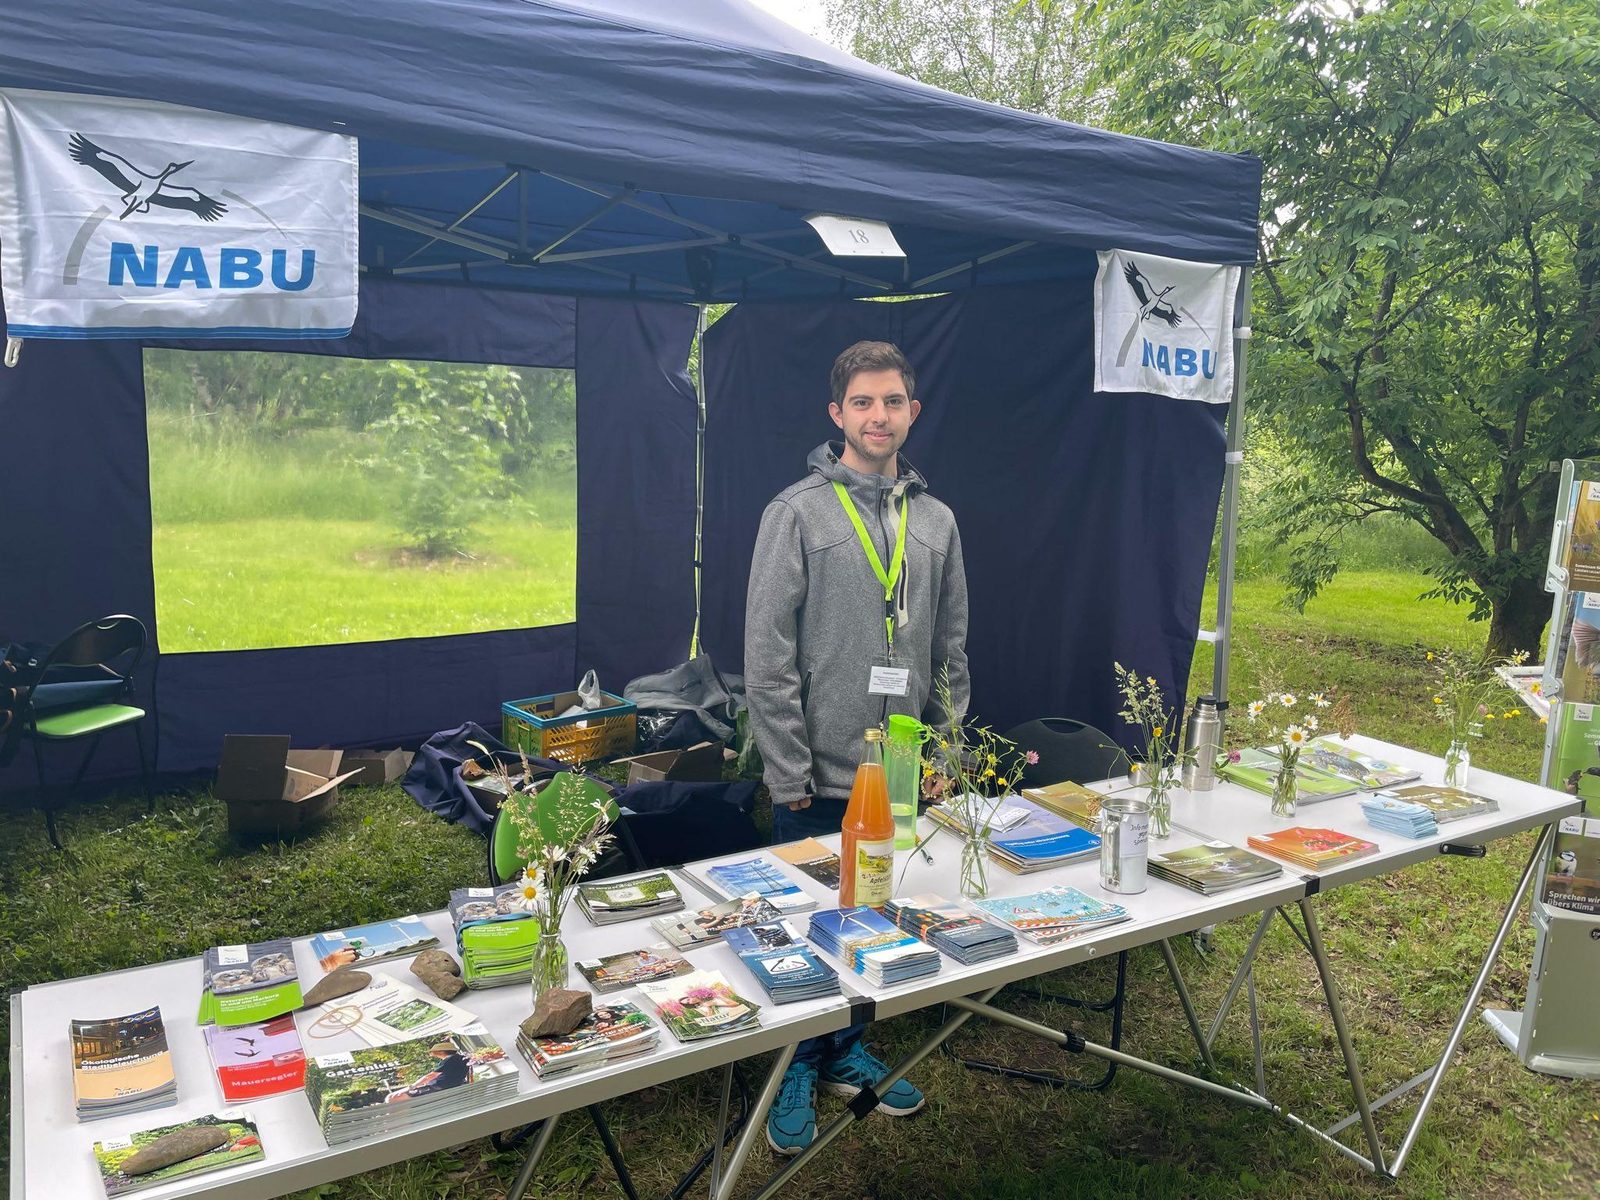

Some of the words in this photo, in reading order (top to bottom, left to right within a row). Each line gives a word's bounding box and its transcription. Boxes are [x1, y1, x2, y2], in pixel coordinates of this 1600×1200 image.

[848, 228, 870, 244] 18
[107, 241, 317, 292] NABU
[1141, 337, 1218, 380] NABU
[1547, 899, 1571, 911] übers
[1571, 901, 1595, 912] Klima
[1548, 890, 1587, 904] Sprechen
[1588, 894, 1600, 904] wir
[80, 1052, 140, 1066] Ökologische
[81, 1050, 164, 1071] Stadtbeleuchtung
[325, 1058, 402, 1078] Gartenlust
[231, 1070, 298, 1087] Mauersegler
